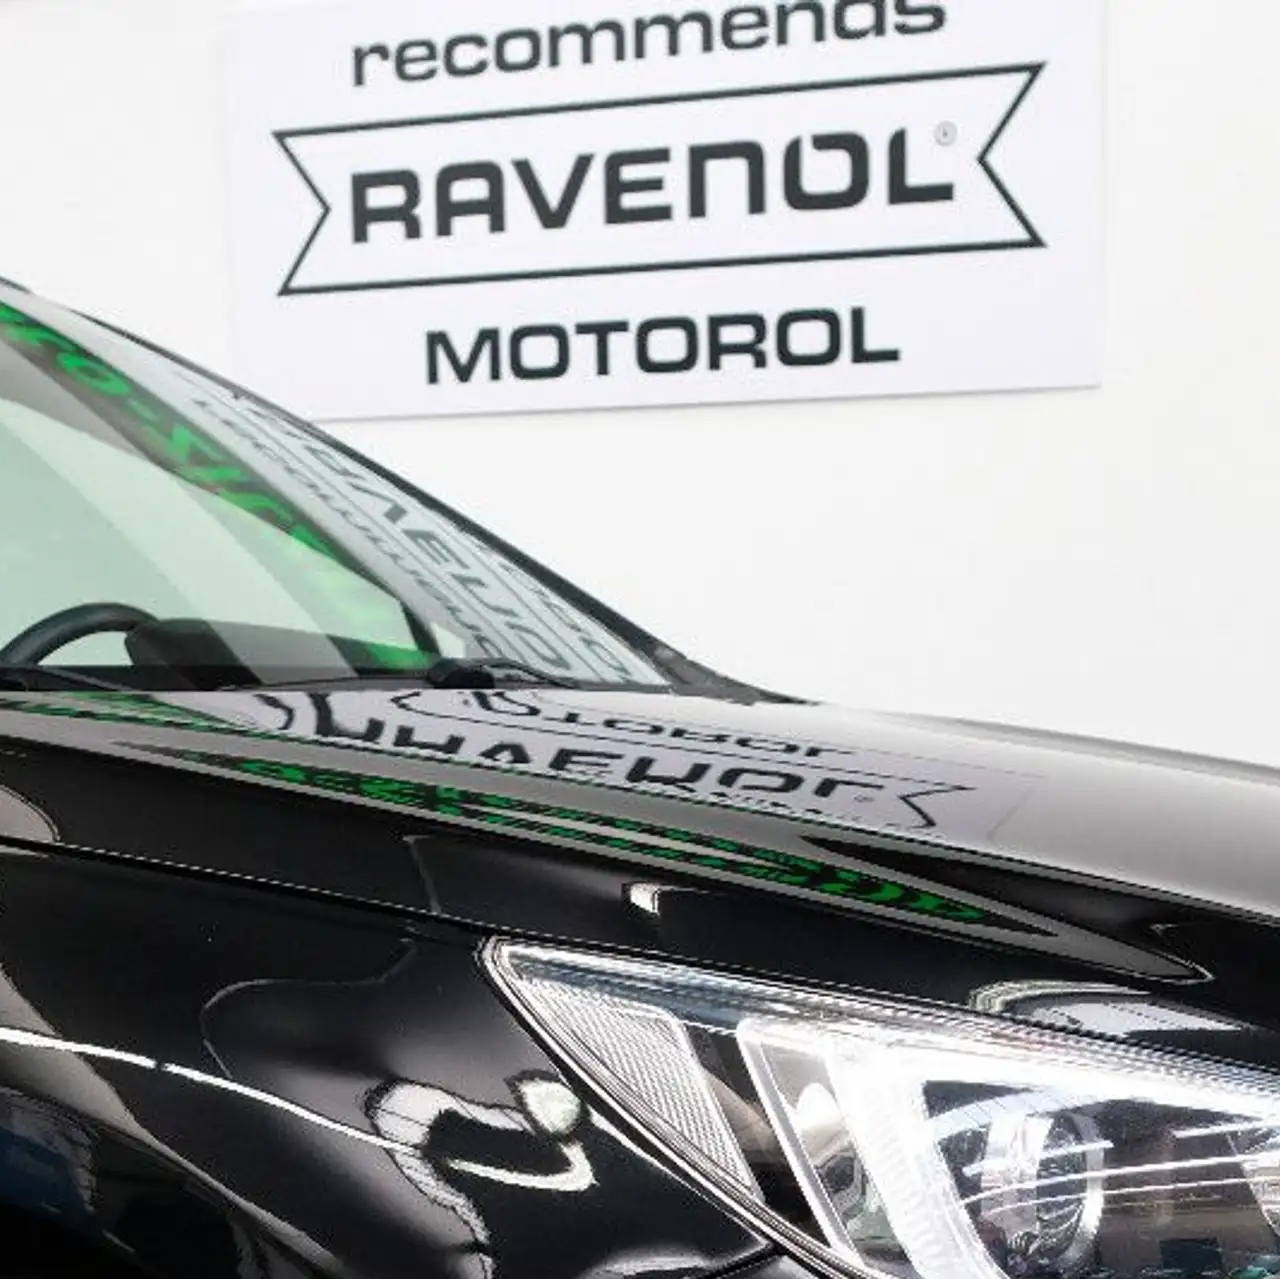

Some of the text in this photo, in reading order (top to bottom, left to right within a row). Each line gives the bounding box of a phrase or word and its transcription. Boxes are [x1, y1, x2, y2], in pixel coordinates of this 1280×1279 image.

[353, 0, 946, 86] recommends
[351, 128, 954, 244] RAVENOL
[426, 306, 900, 385] MOTOROL
